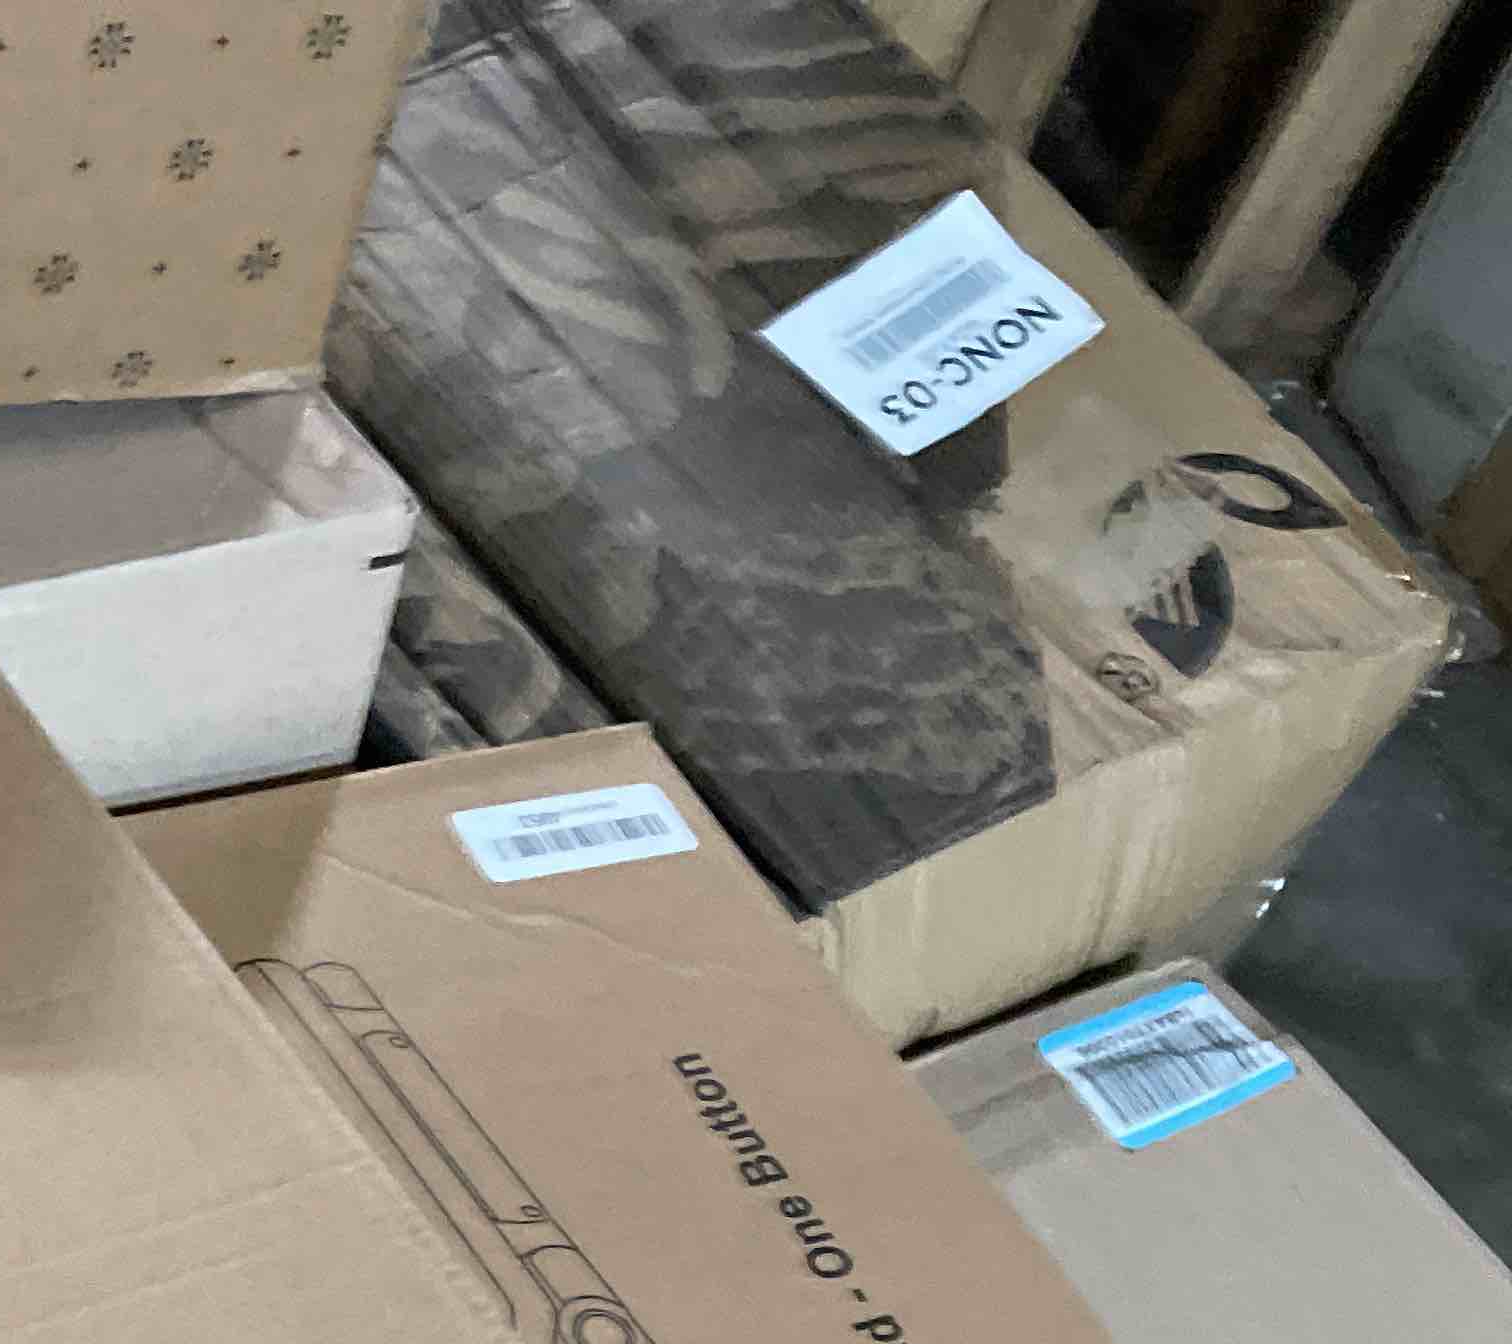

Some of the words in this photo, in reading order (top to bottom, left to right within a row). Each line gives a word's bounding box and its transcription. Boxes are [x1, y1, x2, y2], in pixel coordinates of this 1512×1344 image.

[879, 295, 1065, 426] NONC-03
[672, 1052, 789, 1188] Button
[779, 1194, 854, 1279] One
